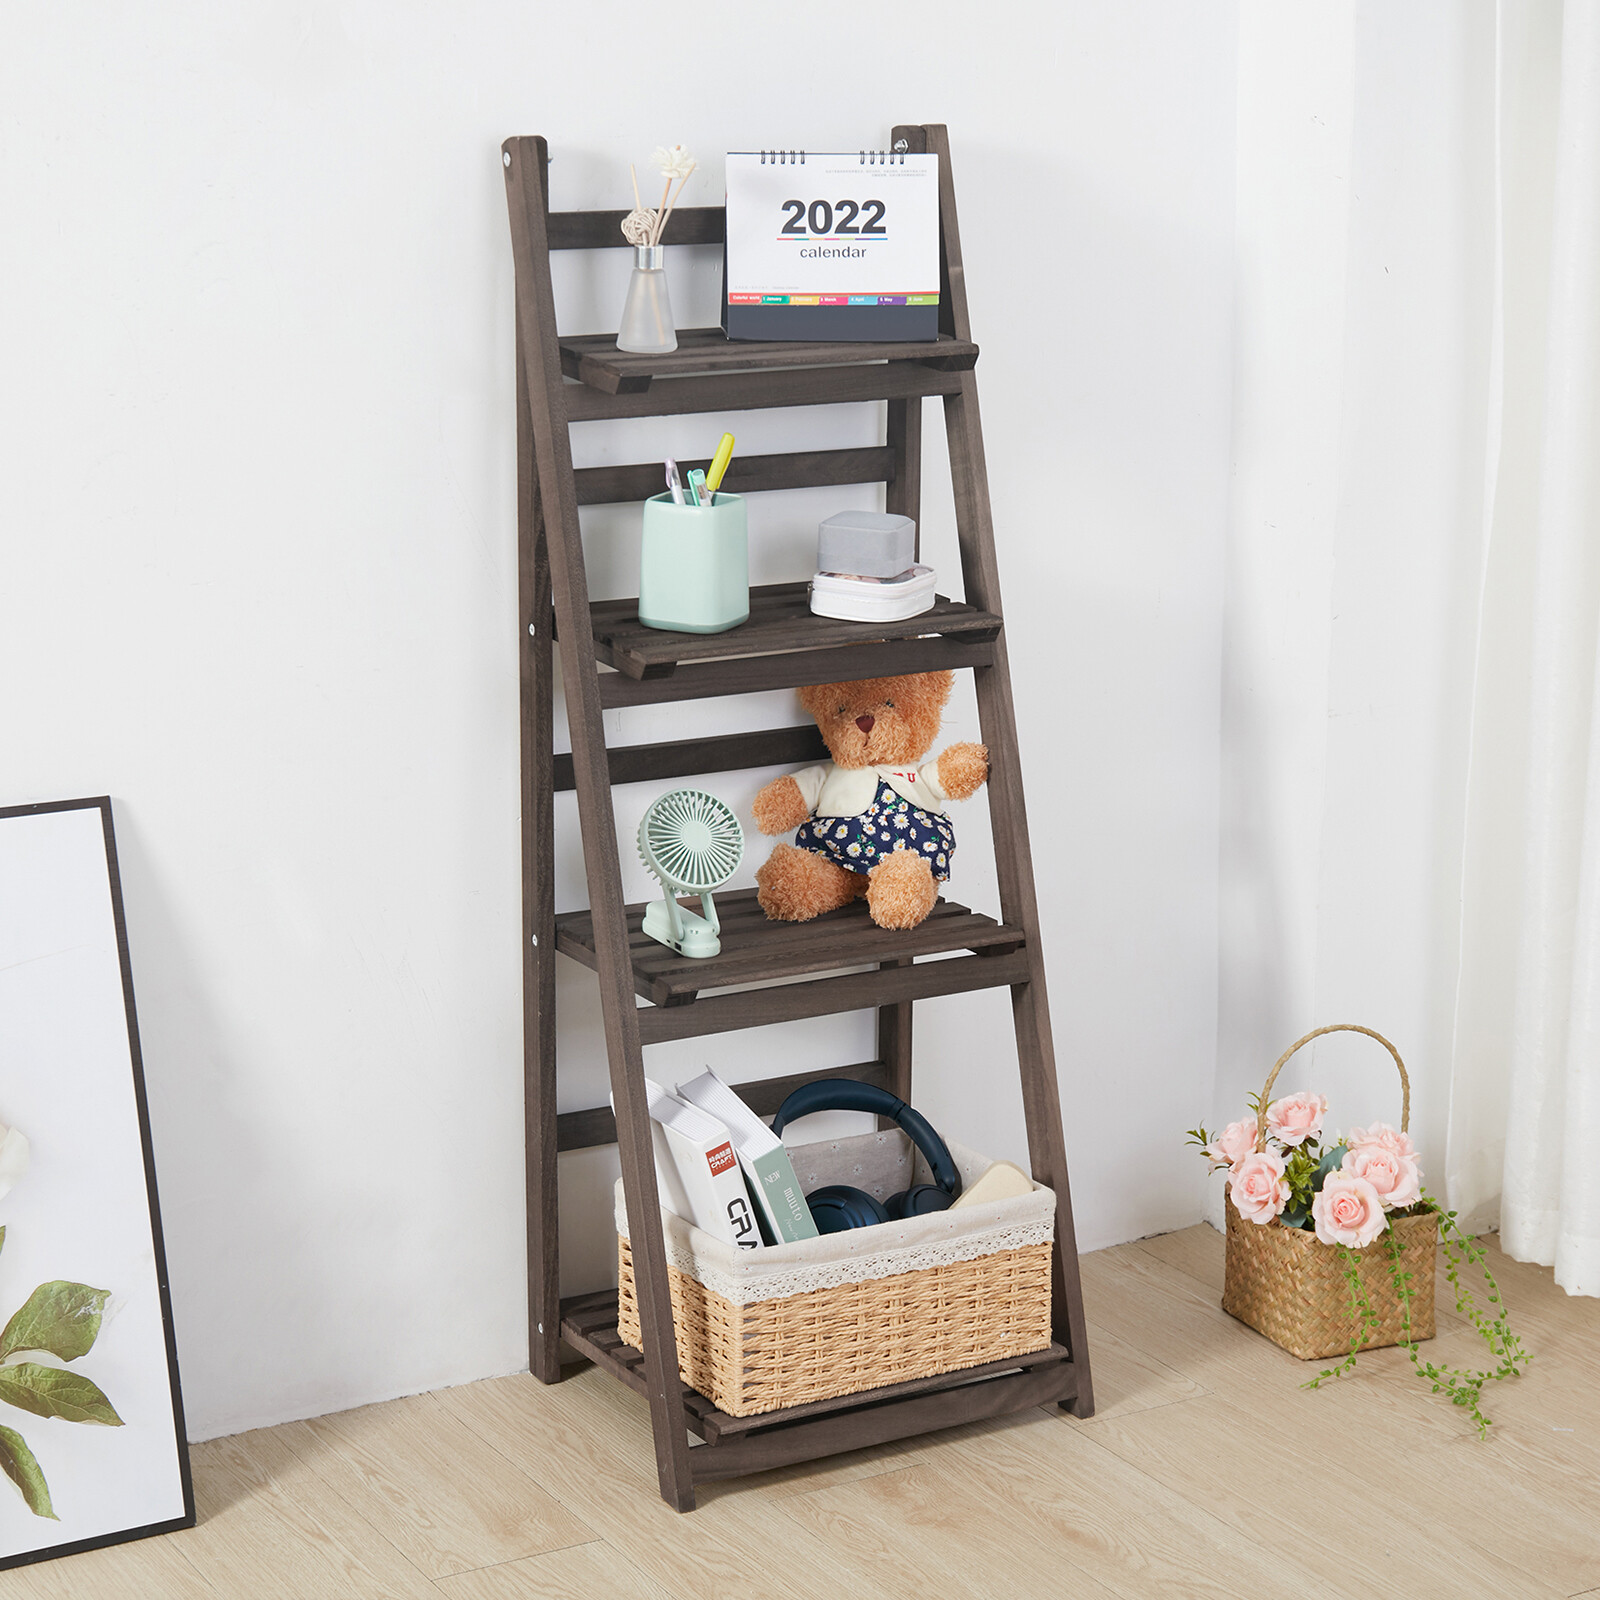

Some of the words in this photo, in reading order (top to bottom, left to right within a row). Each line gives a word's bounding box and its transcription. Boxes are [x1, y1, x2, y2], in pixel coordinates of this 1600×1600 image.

[781, 200, 886, 234] 2022
[800, 246, 867, 258] calendar
[711, 1154, 732, 1169] CRAFT
[784, 1187, 803, 1221] muuto
